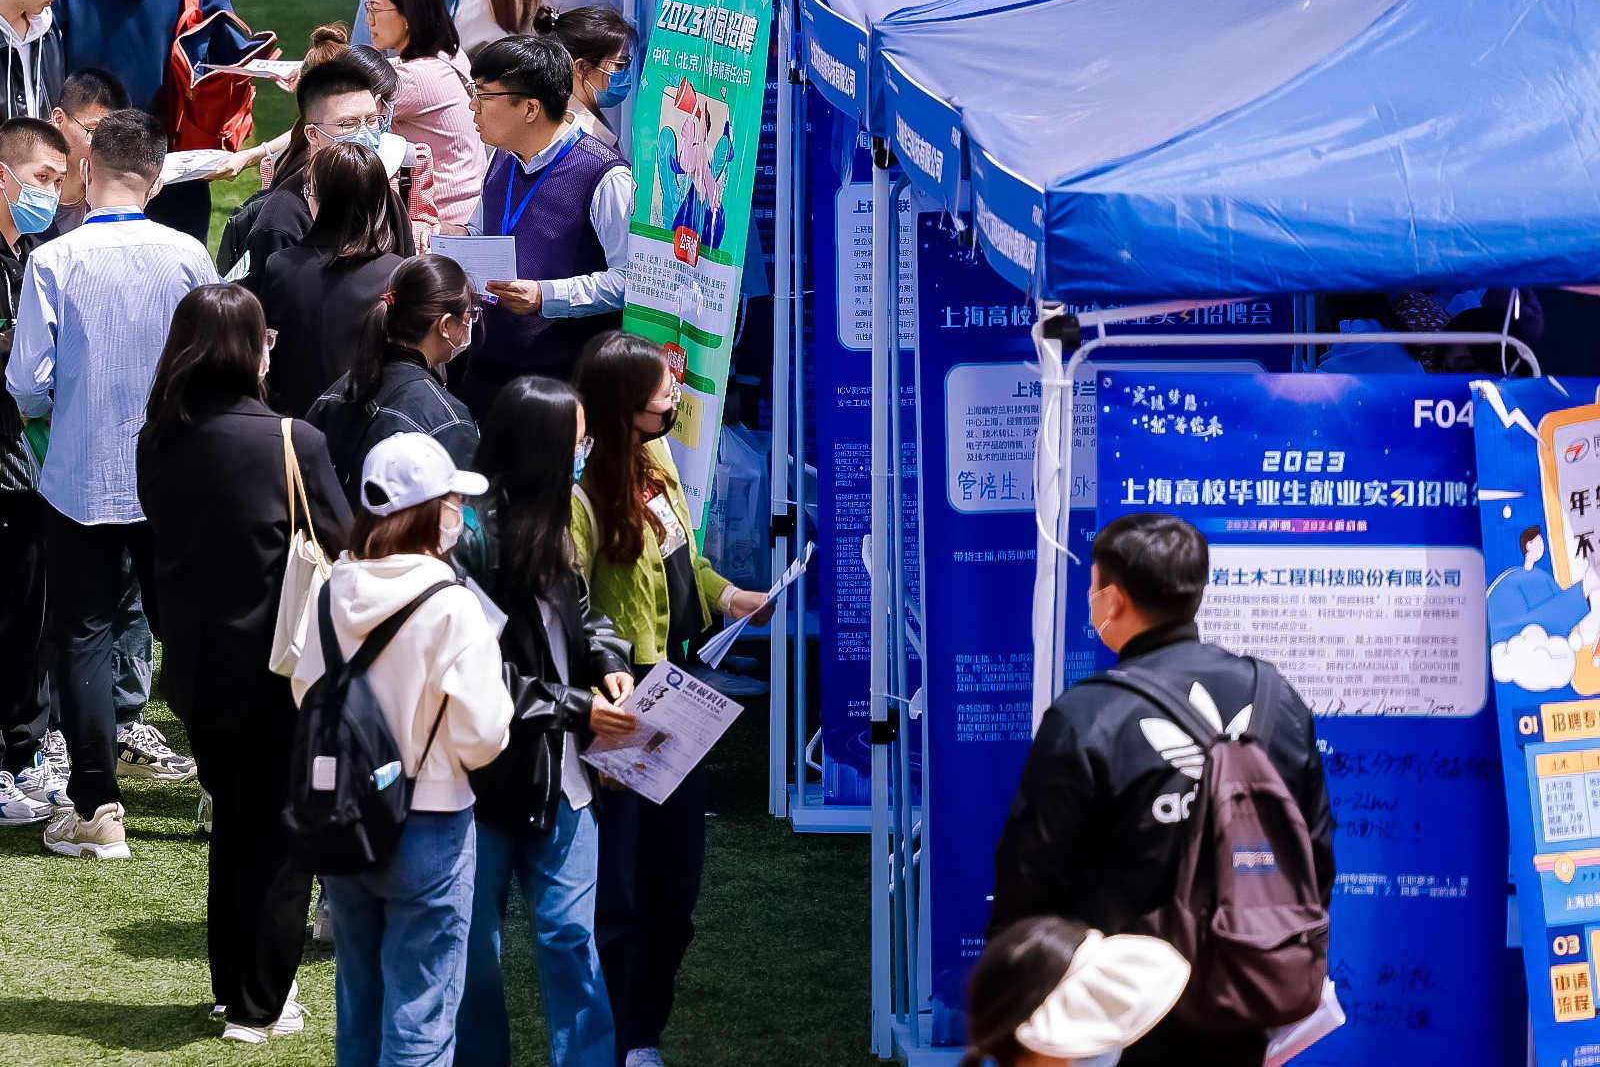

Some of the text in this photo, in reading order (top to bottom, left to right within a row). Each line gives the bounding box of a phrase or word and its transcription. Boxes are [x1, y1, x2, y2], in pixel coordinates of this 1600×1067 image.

[1261, 451, 1347, 474] 2023
[1120, 477, 1482, 508] 上海高校毕业生就业实习招聘
[1569, 488, 1600, 517] 年
[1206, 568, 1461, 588] 岩土木工程科技股份有限公司
[1518, 715, 1539, 735] 01
[1551, 709, 1600, 733] 招聘专
